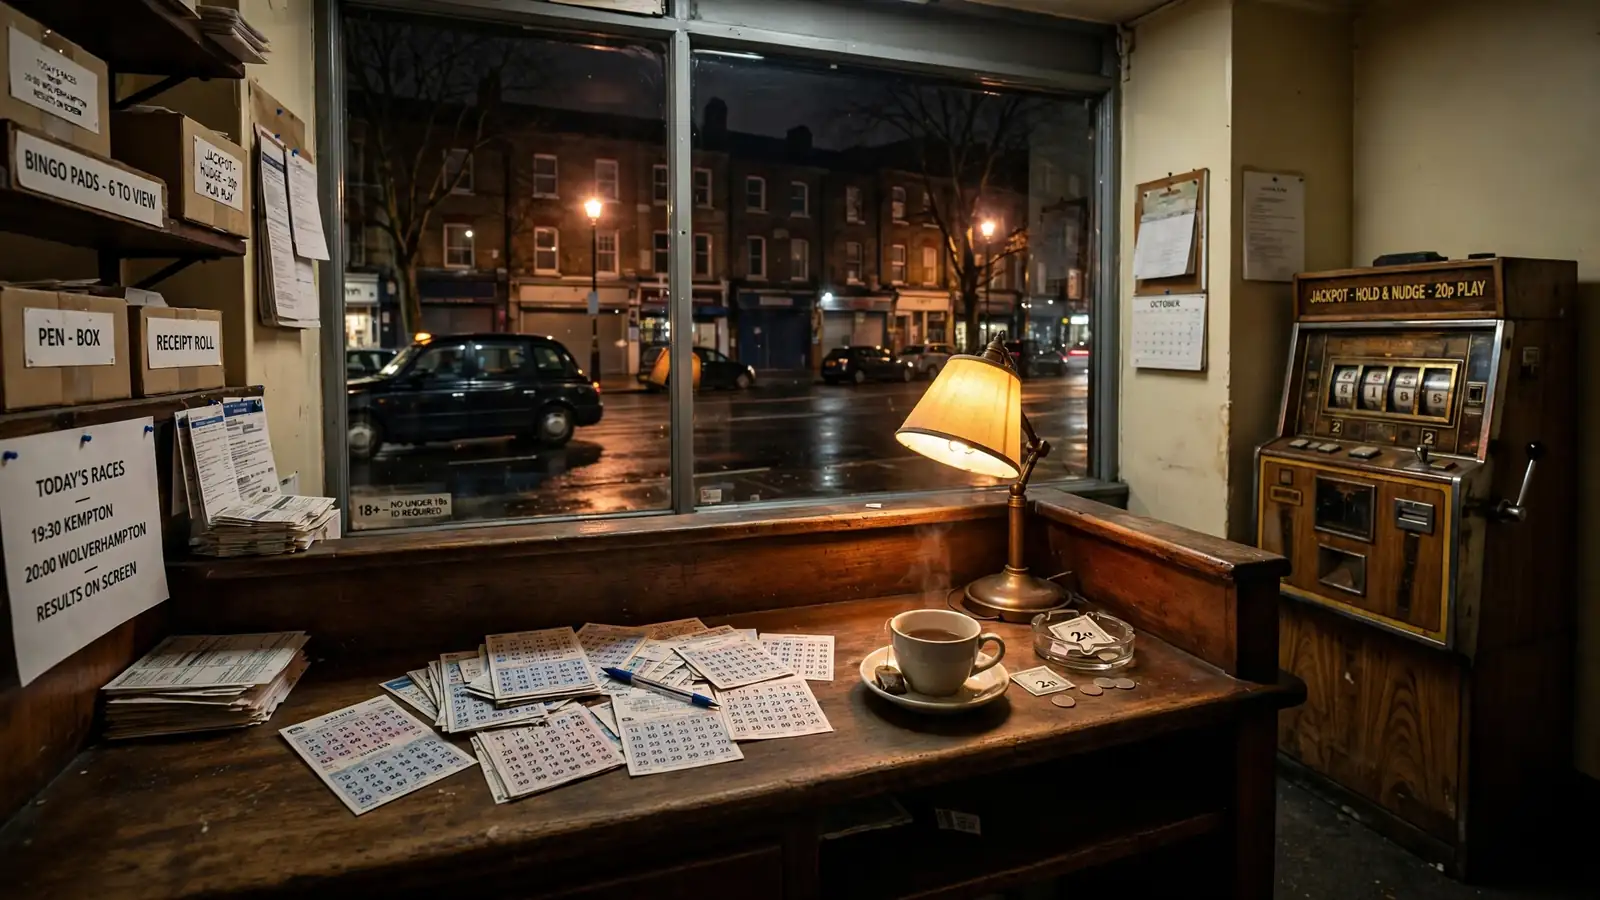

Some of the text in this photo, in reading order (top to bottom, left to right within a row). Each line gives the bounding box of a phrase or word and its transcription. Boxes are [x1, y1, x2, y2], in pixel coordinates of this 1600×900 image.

[25, 149, 67, 181] BINGO
[71, 165, 100, 192] PADS
[109, 180, 115, 196] 6
[117, 181, 131, 201] TO
[132, 187, 156, 210] VIEW
[1310, 288, 1349, 304] JACKPOT
[1355, 287, 1380, 302] HOLD
[1381, 287, 1389, 300] &
[1391, 285, 1425, 300] NUDGE
[1435, 283, 1454, 299] 20p
[1457, 280, 1486, 297] PLAY
[1150, 300, 1180, 308] OCTOBER
[39, 328, 64, 346] PEN
[76, 328, 101, 346] BOX
[157, 334, 214, 350] RECEIPT ROLL
[1332, 422, 1433, 445] 2 2
[36, 460, 125, 498] TODAY'S RACES
[358, 505, 380, 516] 18+
[402, 507, 442, 517] REQUIRED
[405, 498, 432, 507] UNDER
[31, 503, 113, 544] 19:30 KEMPTON
[24, 522, 147, 584] 20:00 WOLVERHAMPTON
[36, 561, 137, 622] RESULTS ON SCREEN
